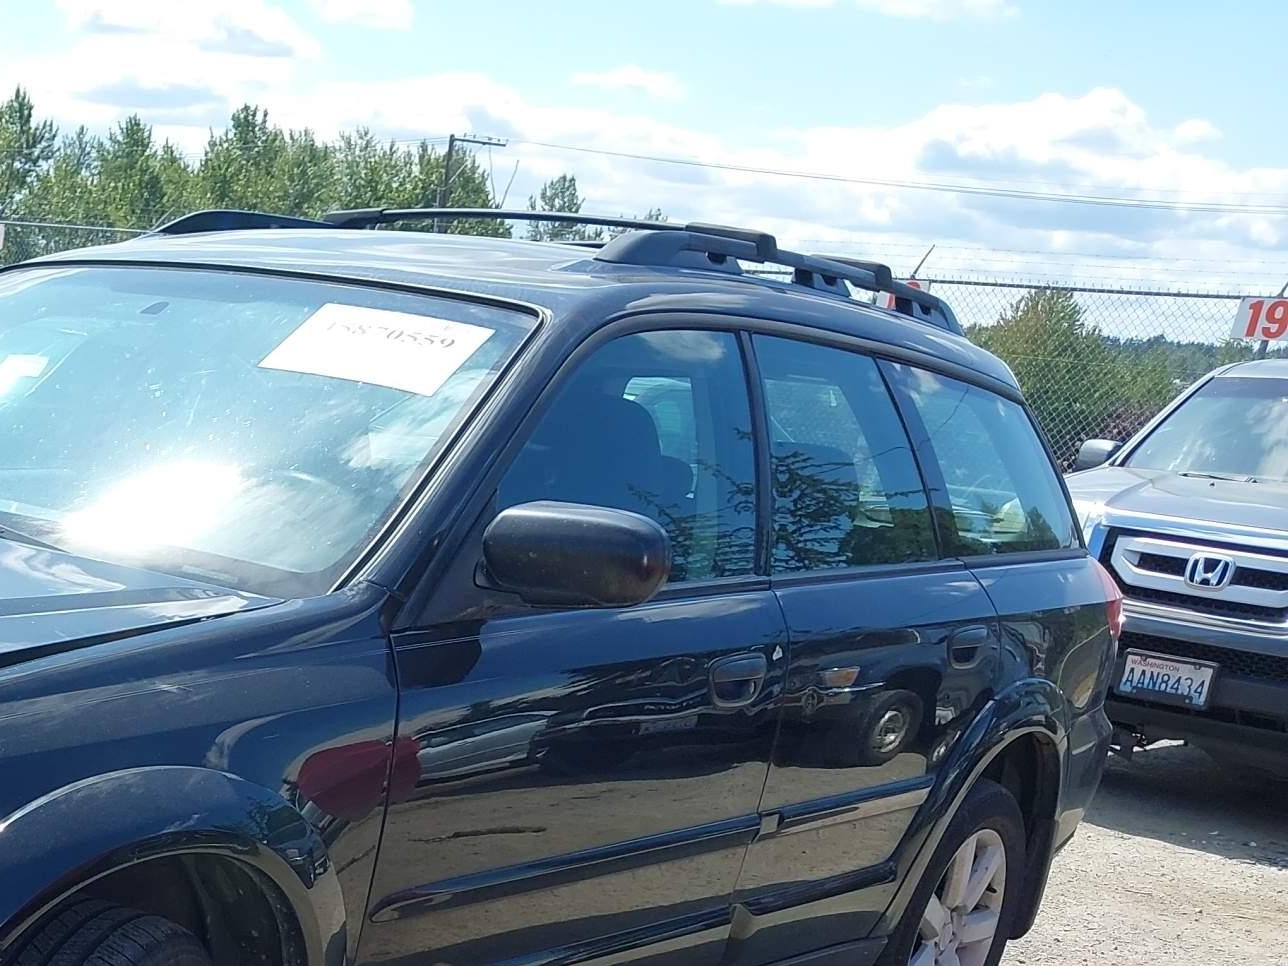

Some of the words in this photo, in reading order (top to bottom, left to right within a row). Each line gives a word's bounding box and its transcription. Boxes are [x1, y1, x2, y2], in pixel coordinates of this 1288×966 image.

[1245, 300, 1288, 339] 19
[1131, 657, 1180, 673] WASHINGTON
[1123, 666, 1207, 699] AAN8434
